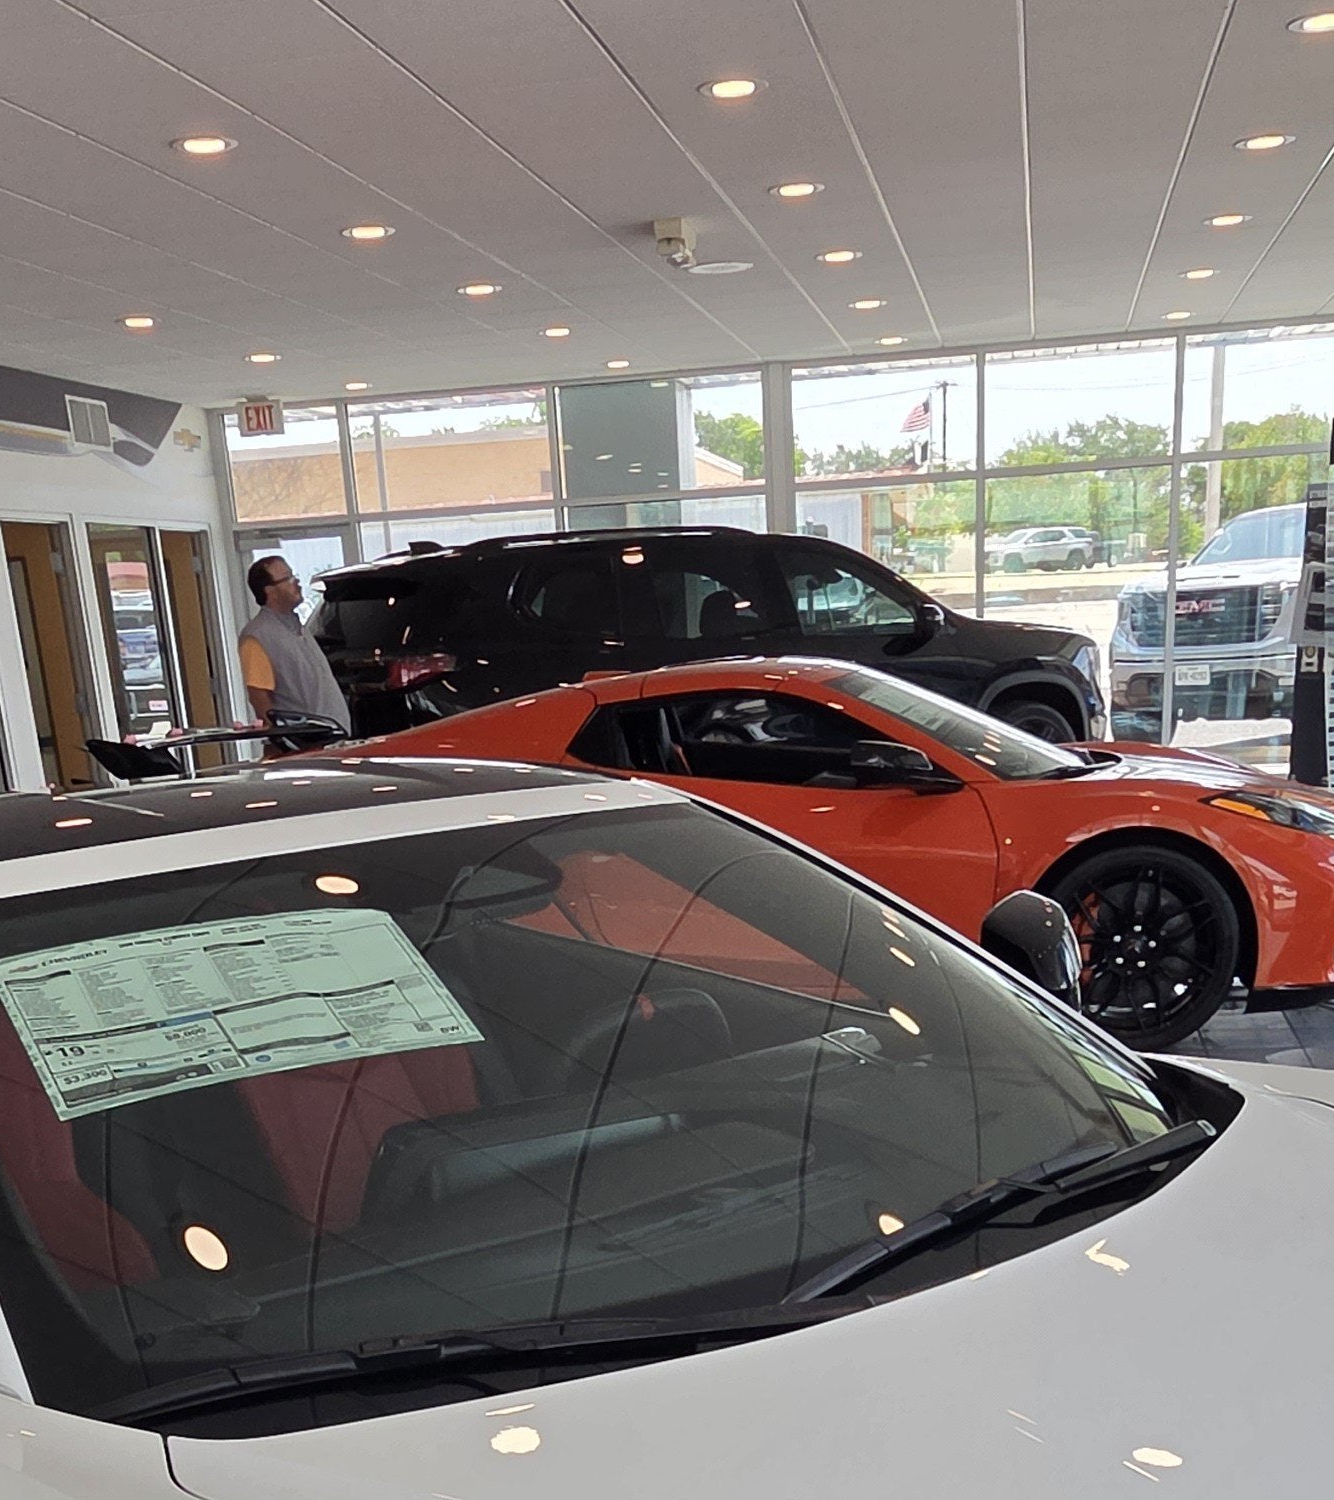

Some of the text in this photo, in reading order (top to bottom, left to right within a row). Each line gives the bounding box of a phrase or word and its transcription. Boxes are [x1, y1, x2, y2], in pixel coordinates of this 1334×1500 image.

[245, 404, 274, 432] EXIT
[41, 949, 107, 967] CHEVROLET
[56, 1045, 85, 1058] 19
